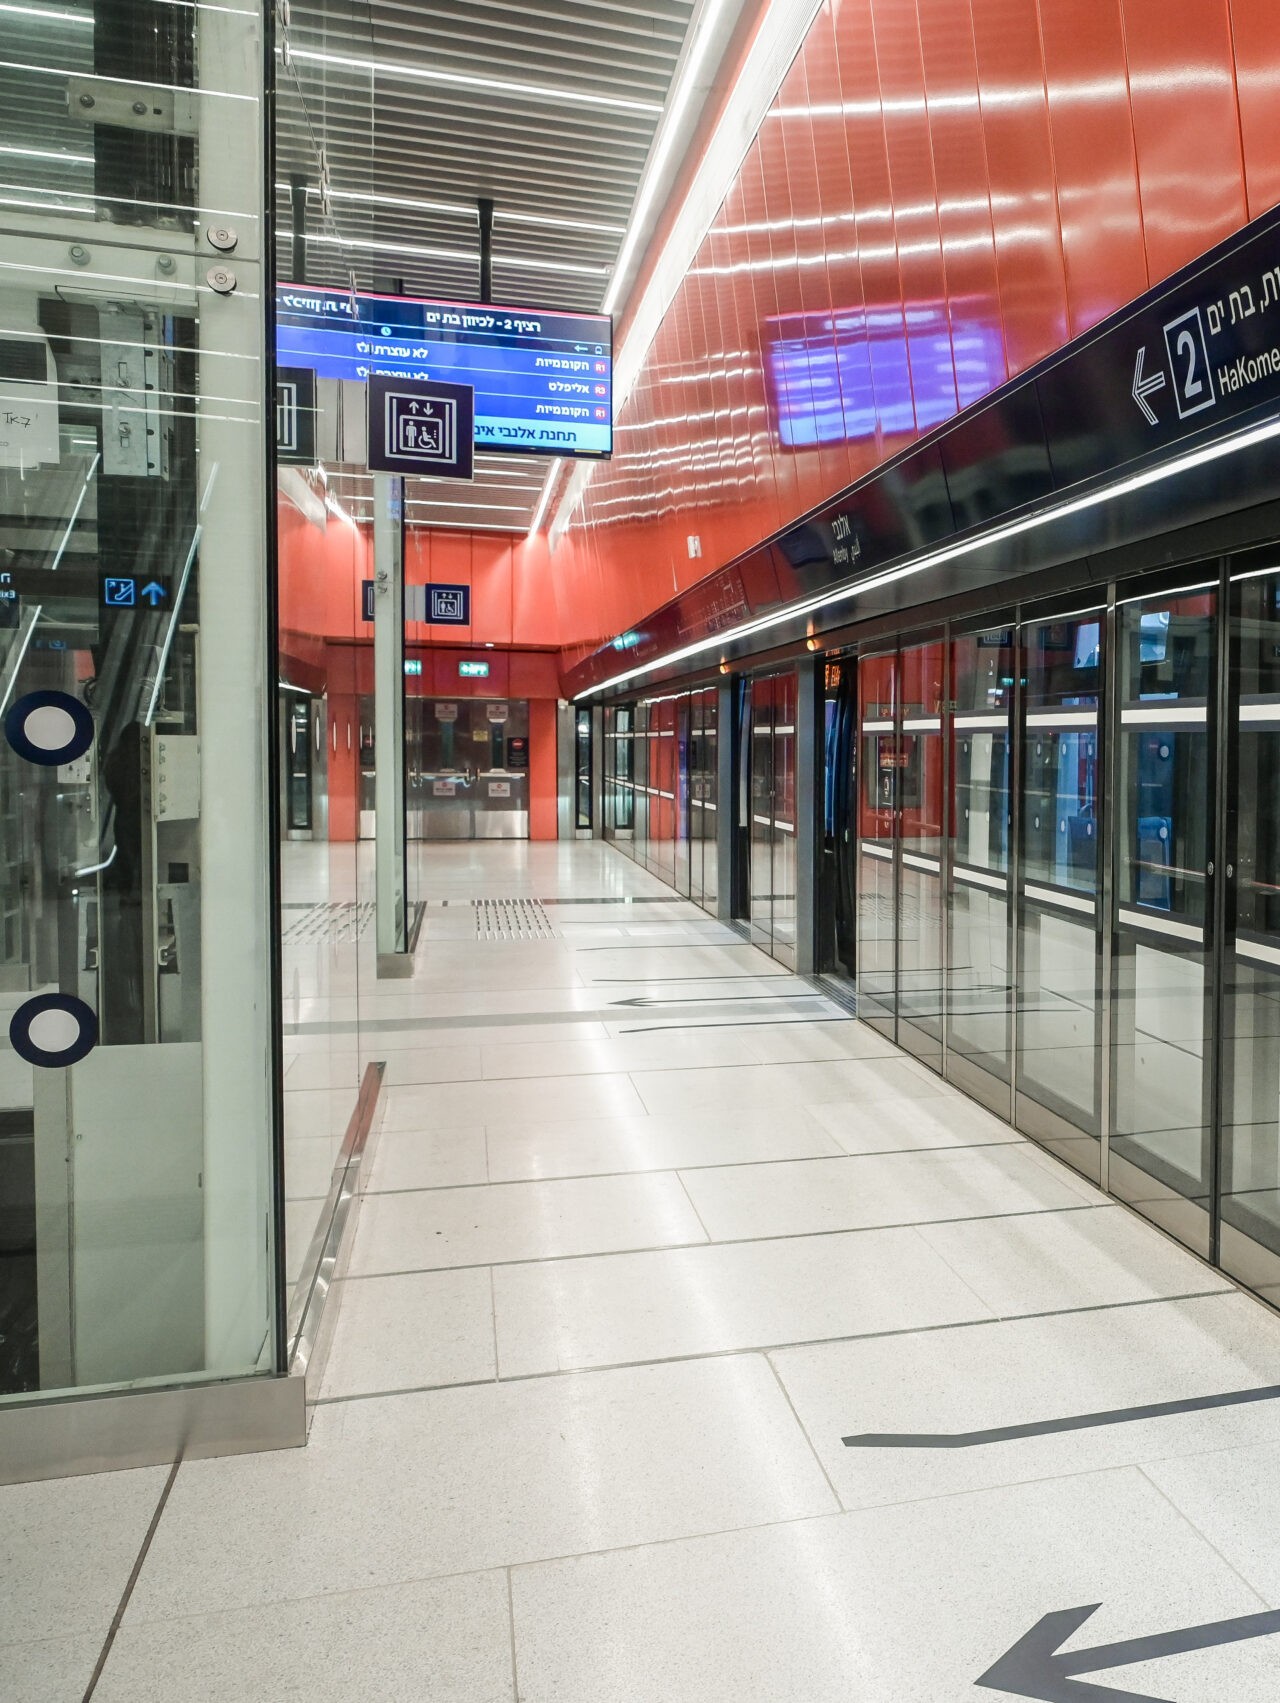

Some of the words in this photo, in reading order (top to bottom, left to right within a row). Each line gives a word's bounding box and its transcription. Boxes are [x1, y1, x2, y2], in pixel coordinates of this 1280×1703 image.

[1228, 285, 1256, 325] בת
[426, 312, 441, 323] ים
[441, 313, 461, 325] בת
[1206, 300, 1225, 336] ים
[503, 319, 513, 330] 2
[513, 320, 541, 333] רציף
[1176, 330, 1203, 399] 2
[497, 426, 536, 439] אלנבי
[539, 429, 577, 442] תחנת
